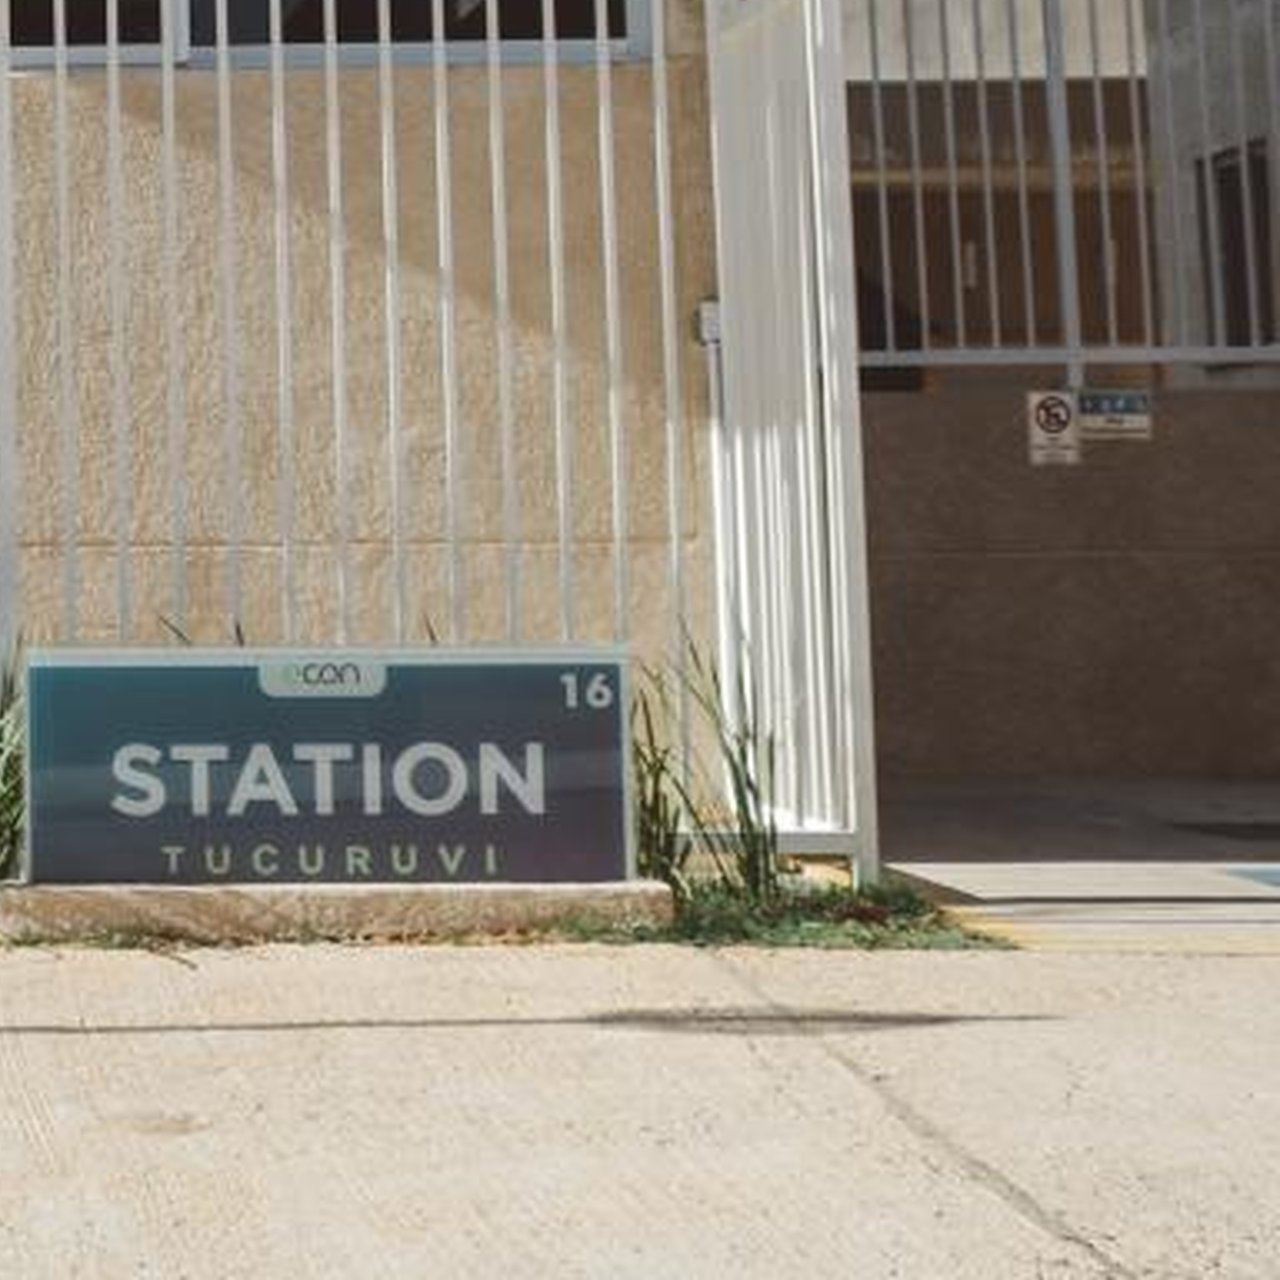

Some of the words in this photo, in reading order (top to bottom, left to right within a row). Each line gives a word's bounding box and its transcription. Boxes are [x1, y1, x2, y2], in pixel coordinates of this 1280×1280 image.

[560, 673, 613, 709] 16
[110, 742, 546, 816] STATION
[161, 844, 498, 874] TUCURUVI
